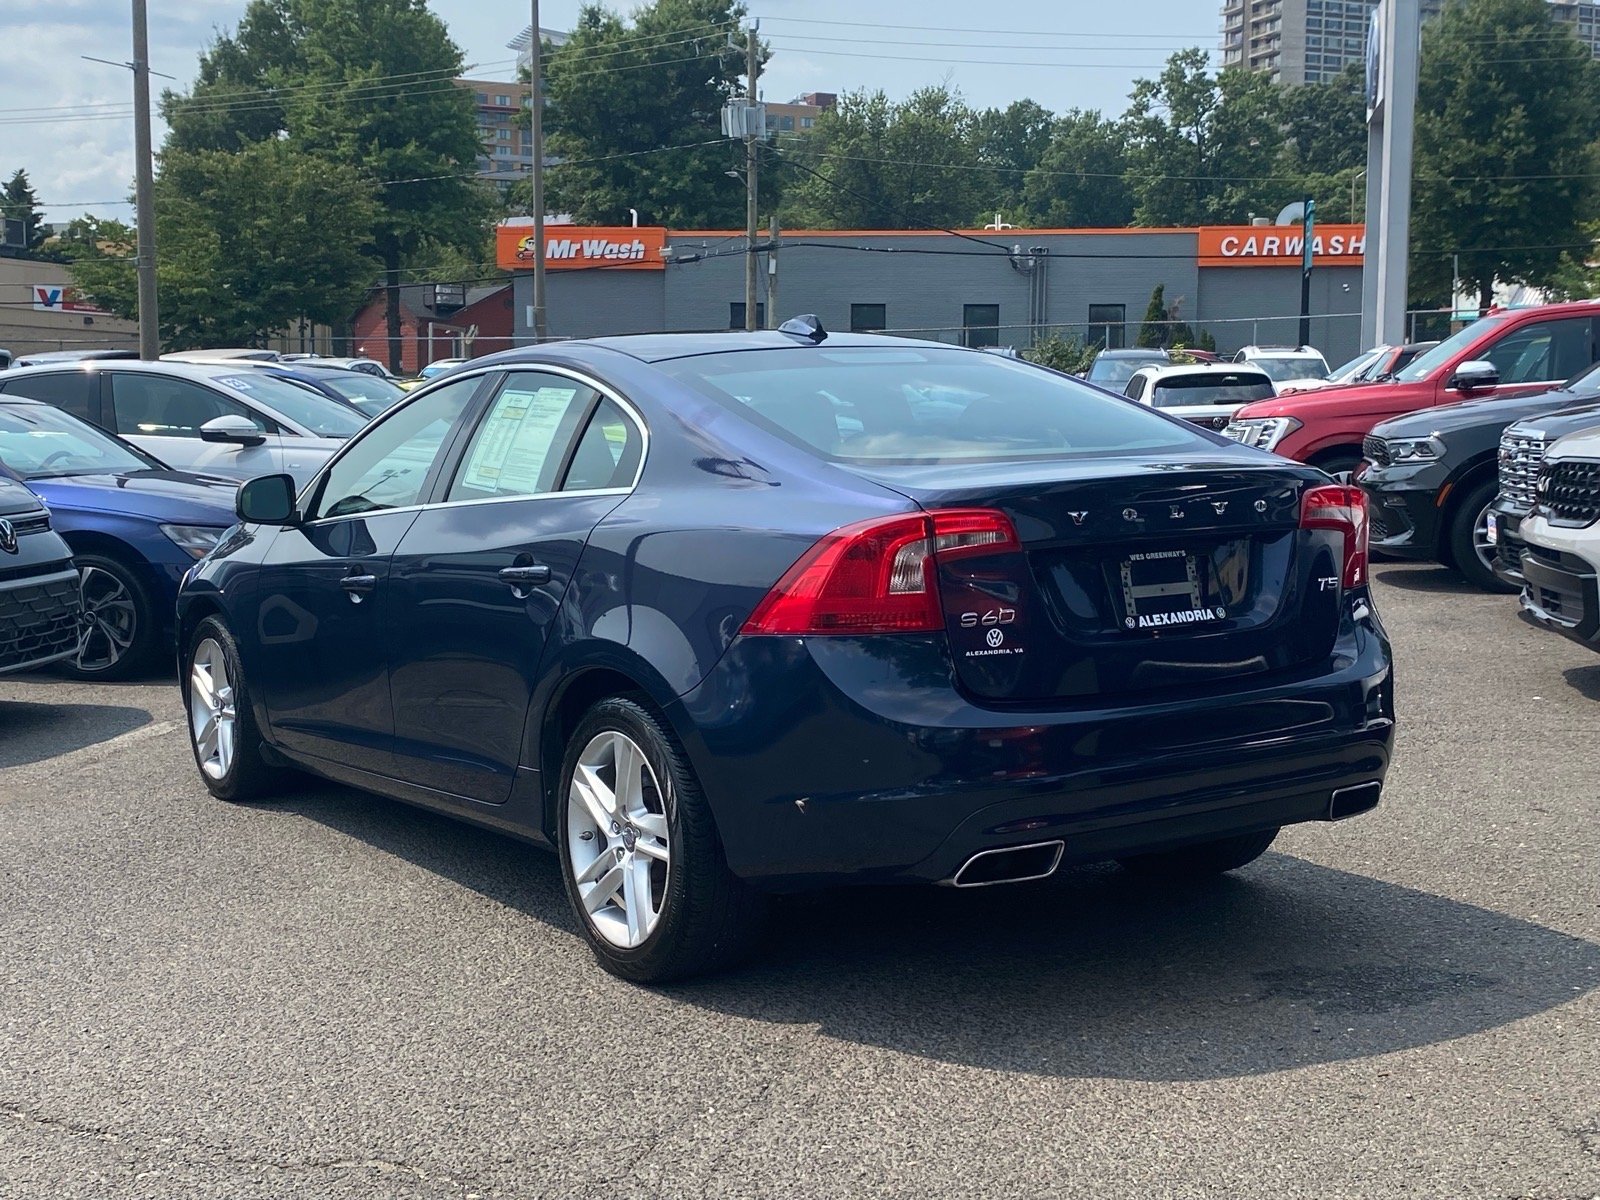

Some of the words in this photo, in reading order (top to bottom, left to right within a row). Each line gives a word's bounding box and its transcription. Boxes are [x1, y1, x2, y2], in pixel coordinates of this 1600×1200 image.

[545, 239, 581, 259] Mr
[583, 239, 645, 259] Wash
[1318, 576, 1338, 591] T5
[961, 608, 1015, 628] S60
[1139, 609, 1215, 627] ALEXANDRIA
[965, 648, 1013, 657] ALEXANDRIA,
